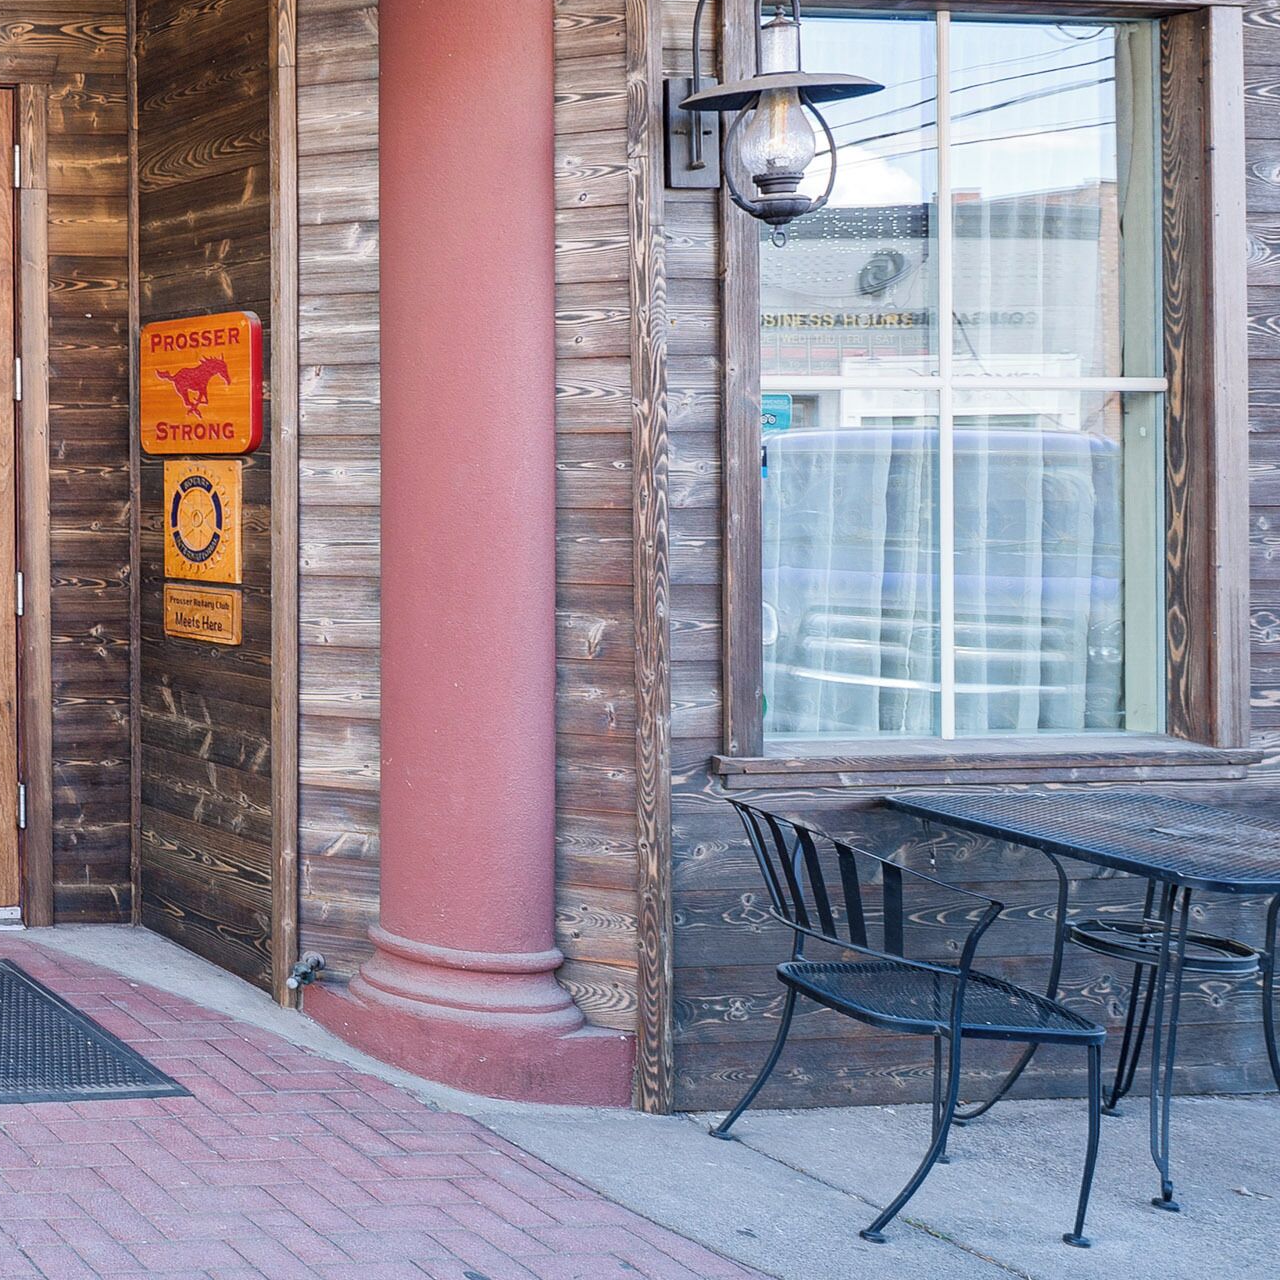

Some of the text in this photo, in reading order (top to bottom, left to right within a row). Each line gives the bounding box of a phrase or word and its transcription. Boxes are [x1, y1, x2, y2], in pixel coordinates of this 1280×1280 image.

[761, 312, 913, 328] SINESS HOURS
[150, 327, 240, 353] PROSSER
[846, 335, 864, 344] FRI
[875, 335, 896, 344] SAT
[156, 421, 235, 441] STRONG
[169, 595, 230, 610] Prosser Rotary Club
[175, 611, 223, 632] Meets Here
